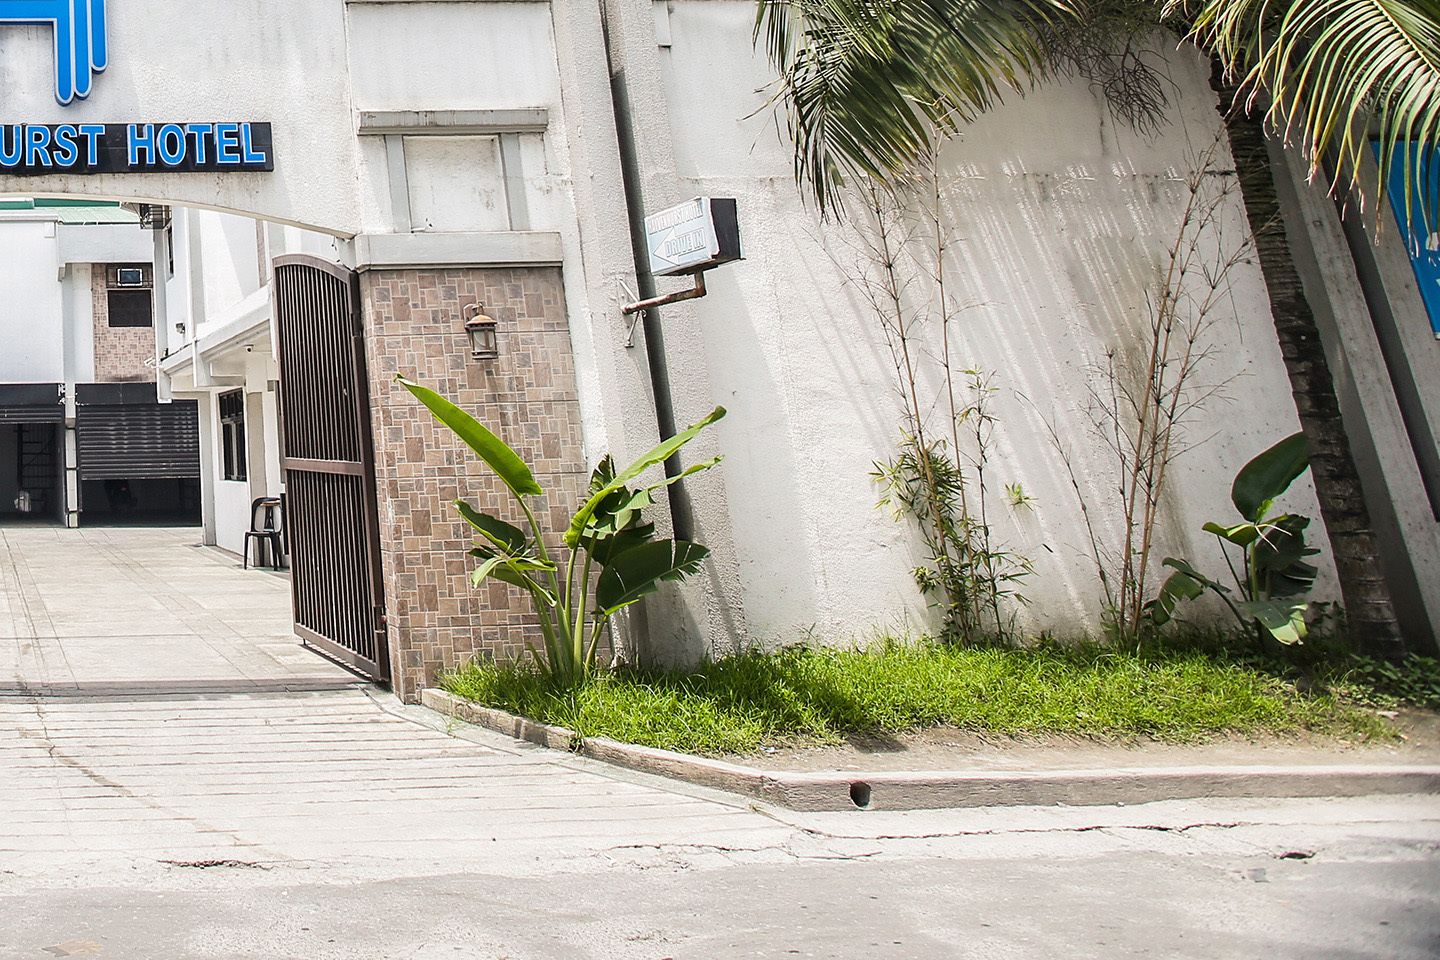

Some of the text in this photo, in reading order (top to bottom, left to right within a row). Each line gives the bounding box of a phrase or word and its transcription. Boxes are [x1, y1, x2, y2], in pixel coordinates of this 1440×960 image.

[127, 122, 266, 166] HOTEL
[665, 230, 704, 257] DRIVE IN
